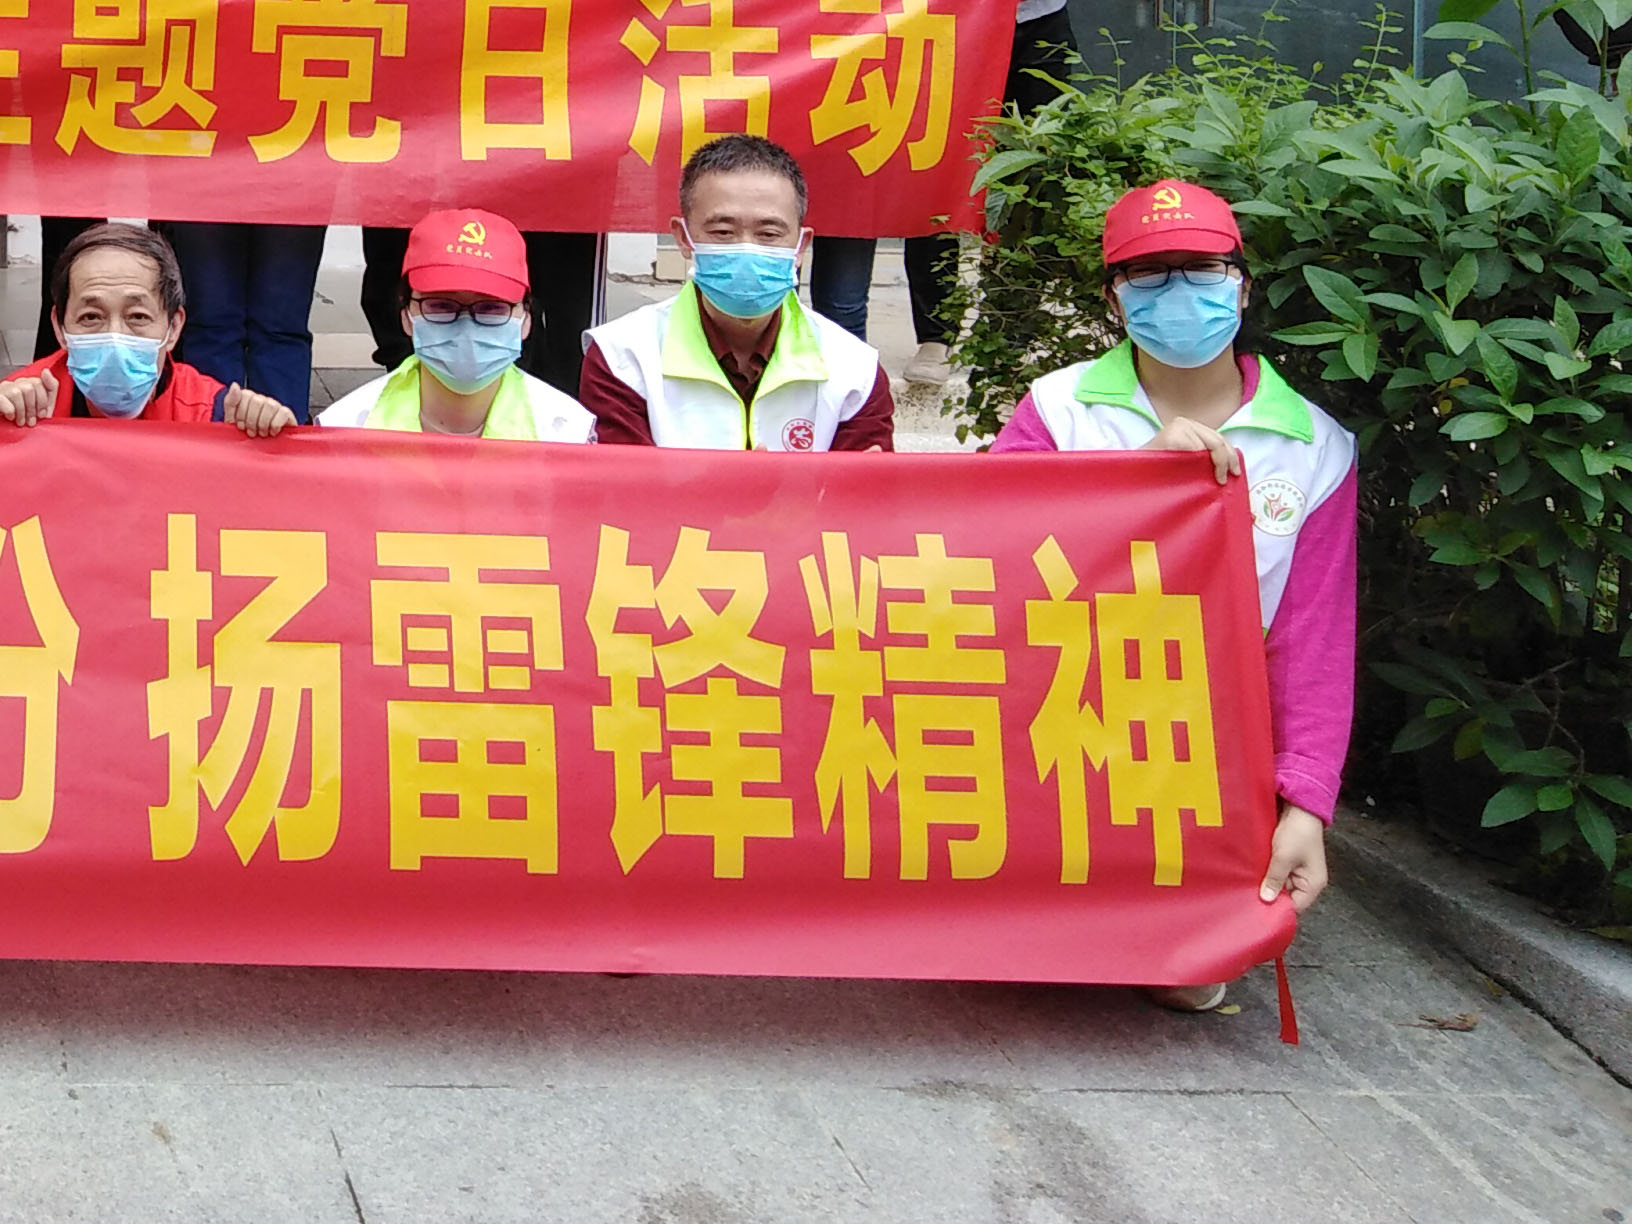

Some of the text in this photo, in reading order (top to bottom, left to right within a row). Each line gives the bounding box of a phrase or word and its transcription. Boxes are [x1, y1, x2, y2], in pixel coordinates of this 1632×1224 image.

[146, 513, 1224, 888] 扬雷锋精神
